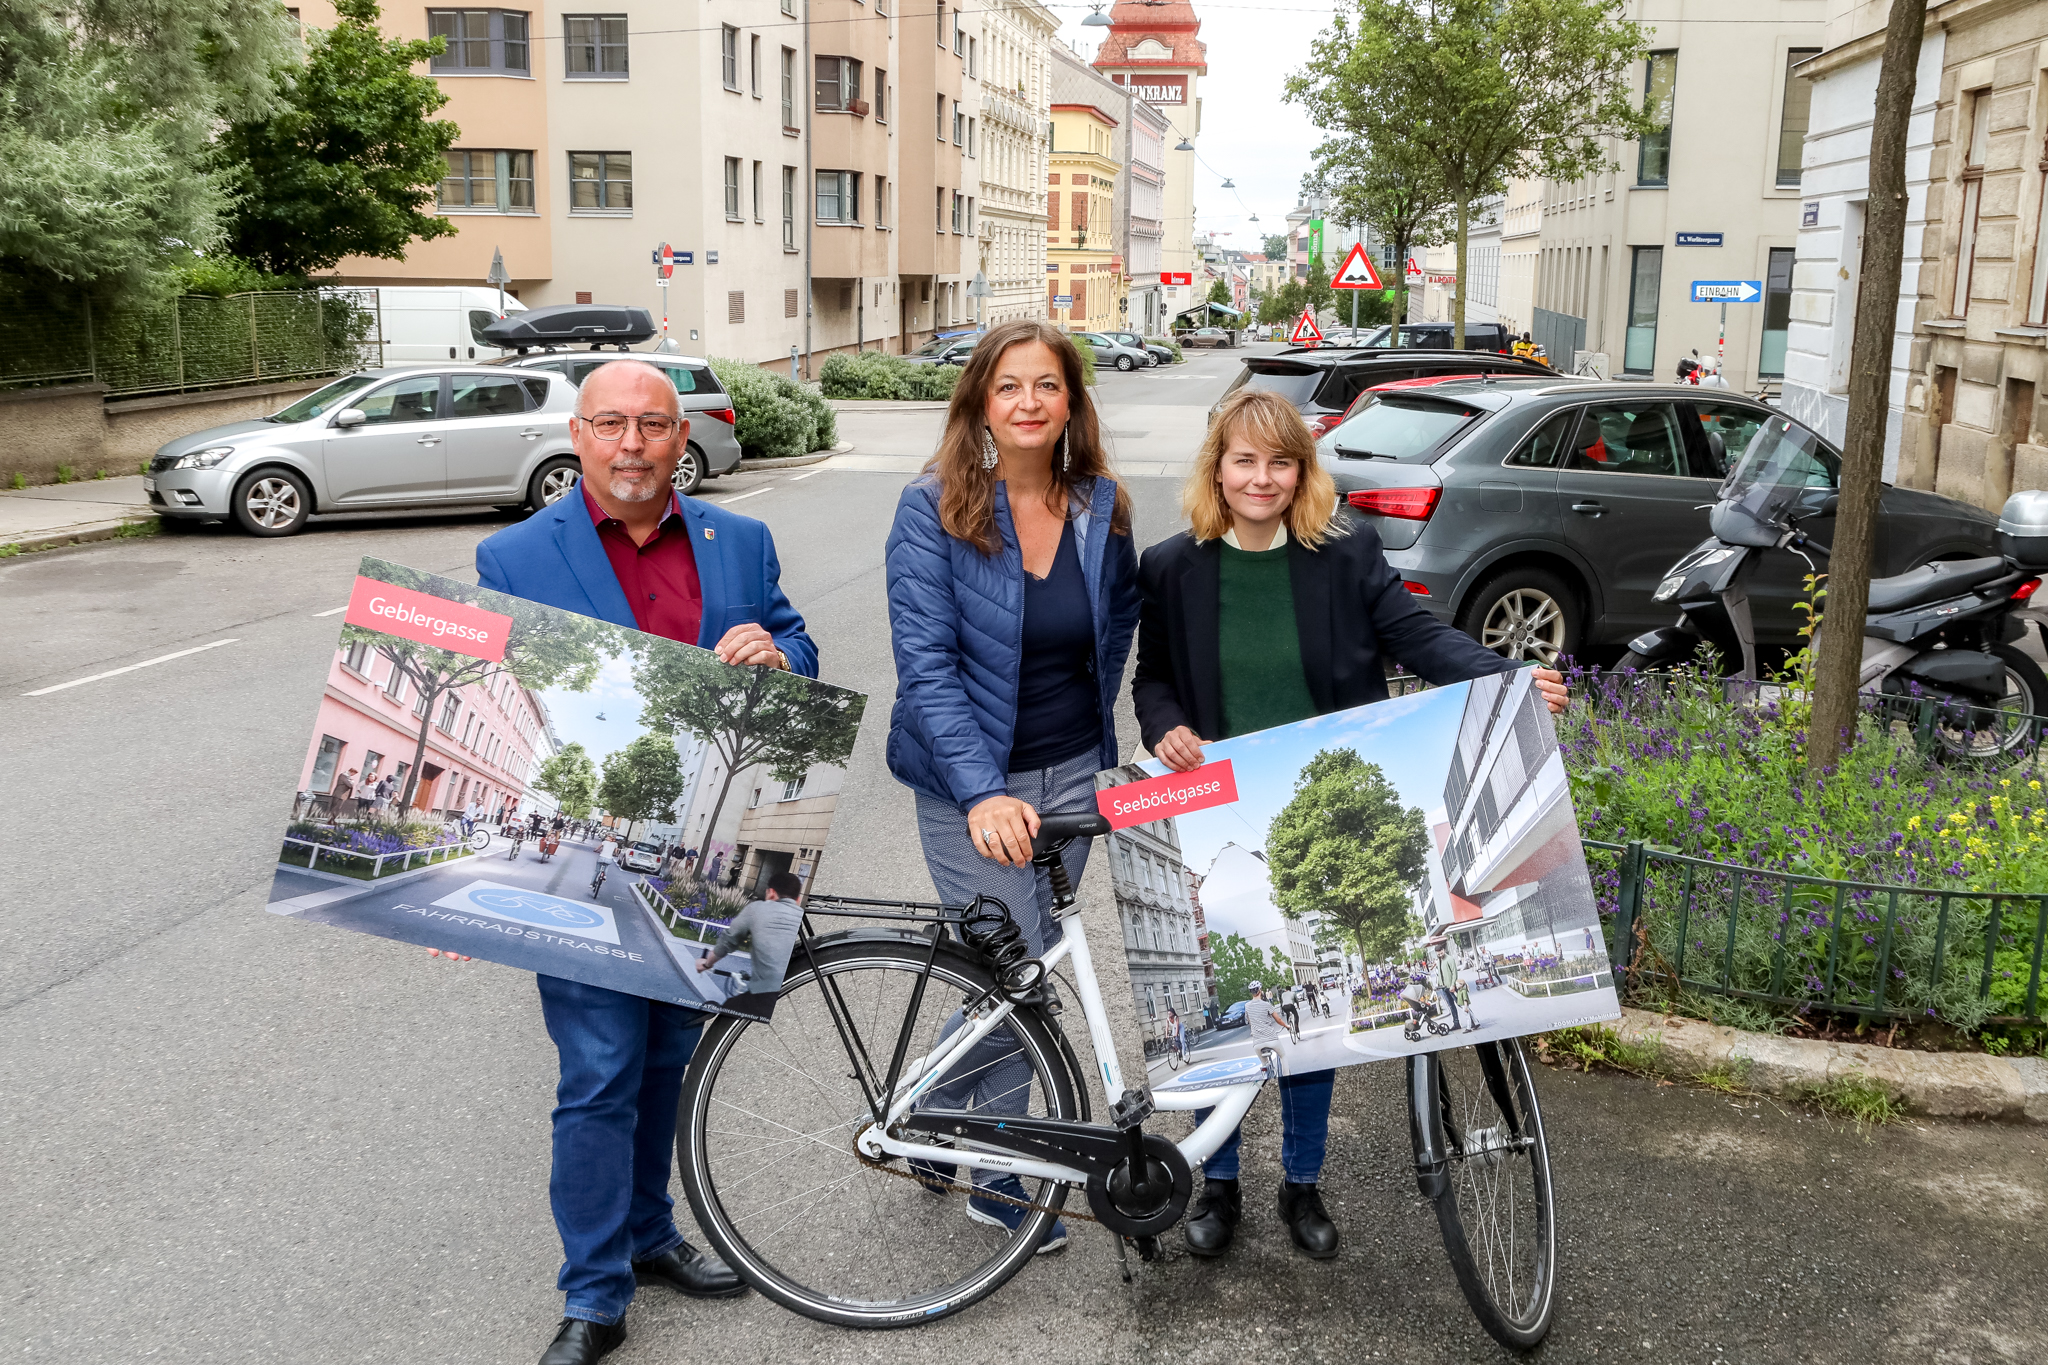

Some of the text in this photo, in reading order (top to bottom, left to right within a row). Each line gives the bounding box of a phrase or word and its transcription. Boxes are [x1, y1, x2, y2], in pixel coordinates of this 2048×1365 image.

[1699, 286, 1740, 297] EINBAHN
[369, 597, 488, 643] Geblergasse
[1113, 781, 1221, 816] Seeböckgasse
[391, 903, 645, 963] FAHRRADSTRASSE
[978, 1157, 1013, 1167] Kalkhoff
